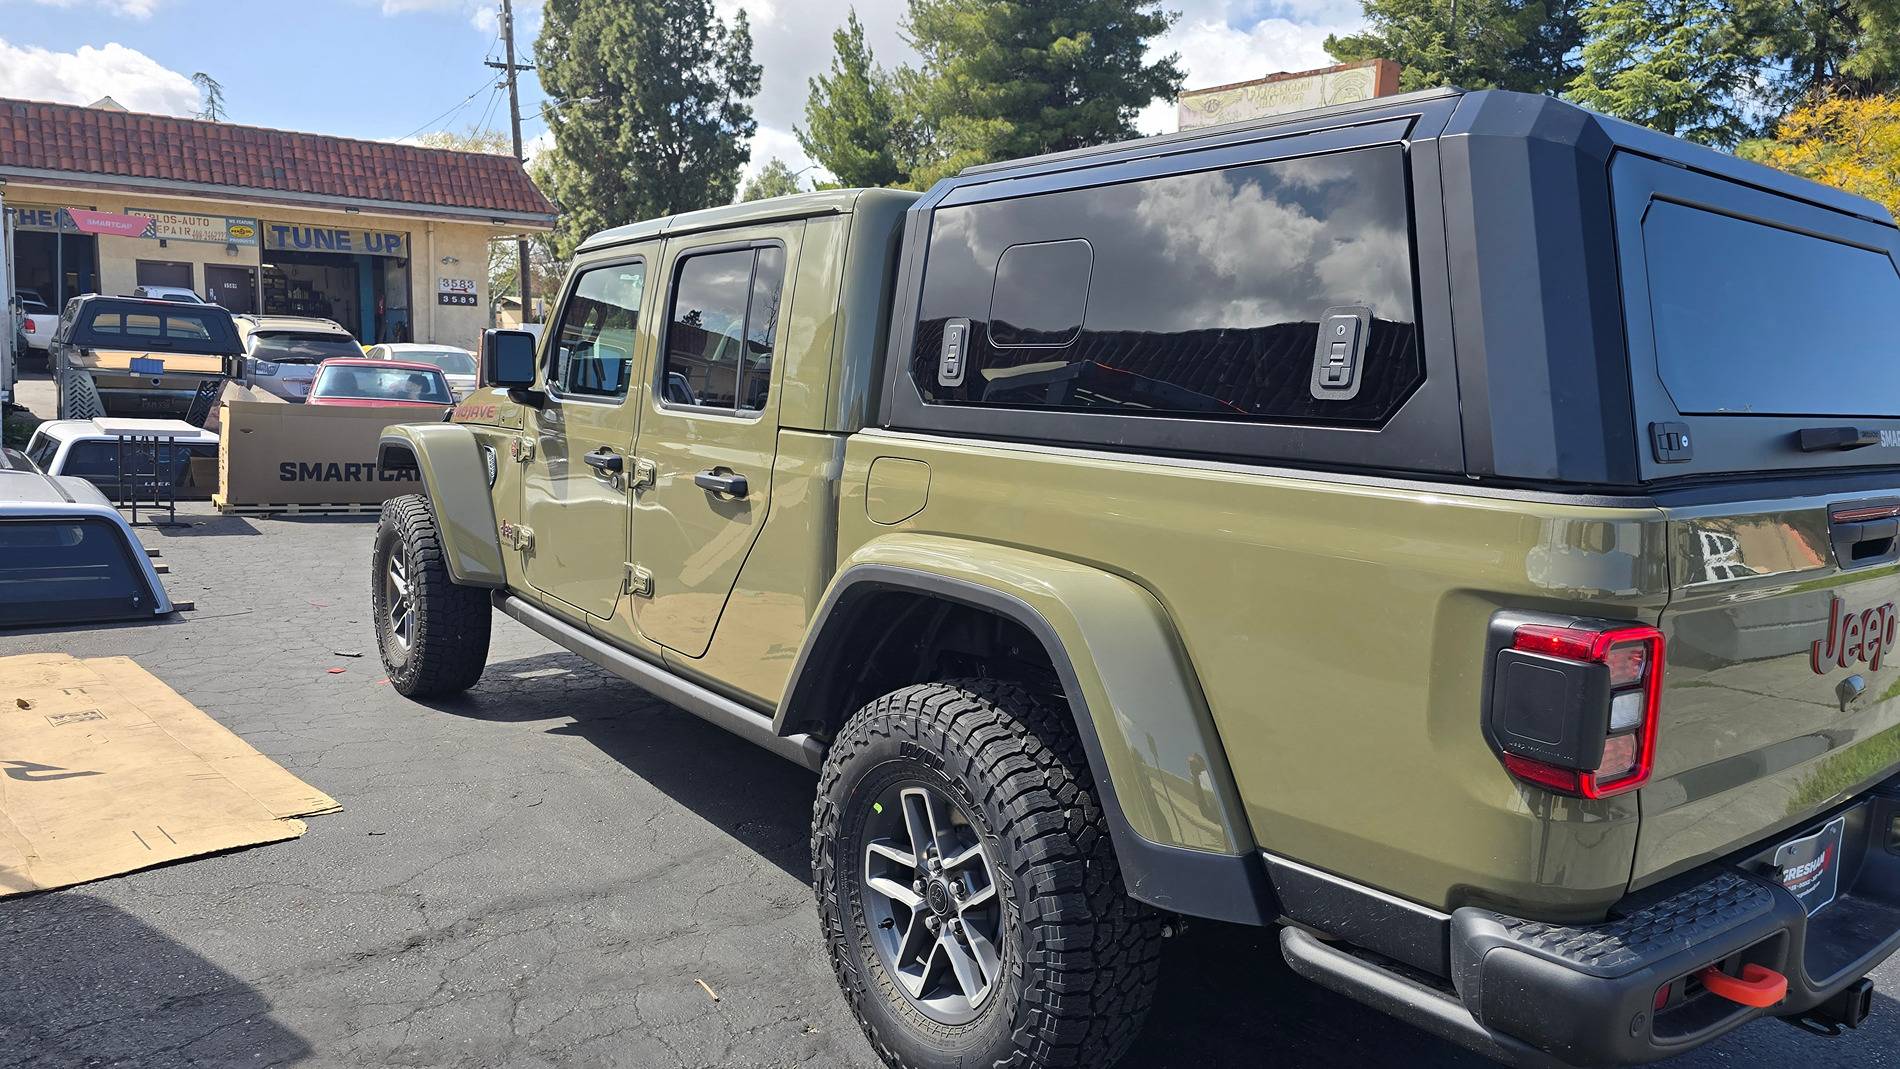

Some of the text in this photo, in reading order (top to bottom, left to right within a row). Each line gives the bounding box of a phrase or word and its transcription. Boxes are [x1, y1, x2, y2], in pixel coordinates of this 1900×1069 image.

[87, 219, 133, 230] SMARTCAP
[156, 225, 192, 236] EPAIR
[271, 225, 401, 253] TUNE UP
[442, 278, 474, 289] 3583
[443, 295, 475, 304] 3589
[279, 462, 422, 482] SMARTCA
[1810, 598, 1899, 675] Jeep
